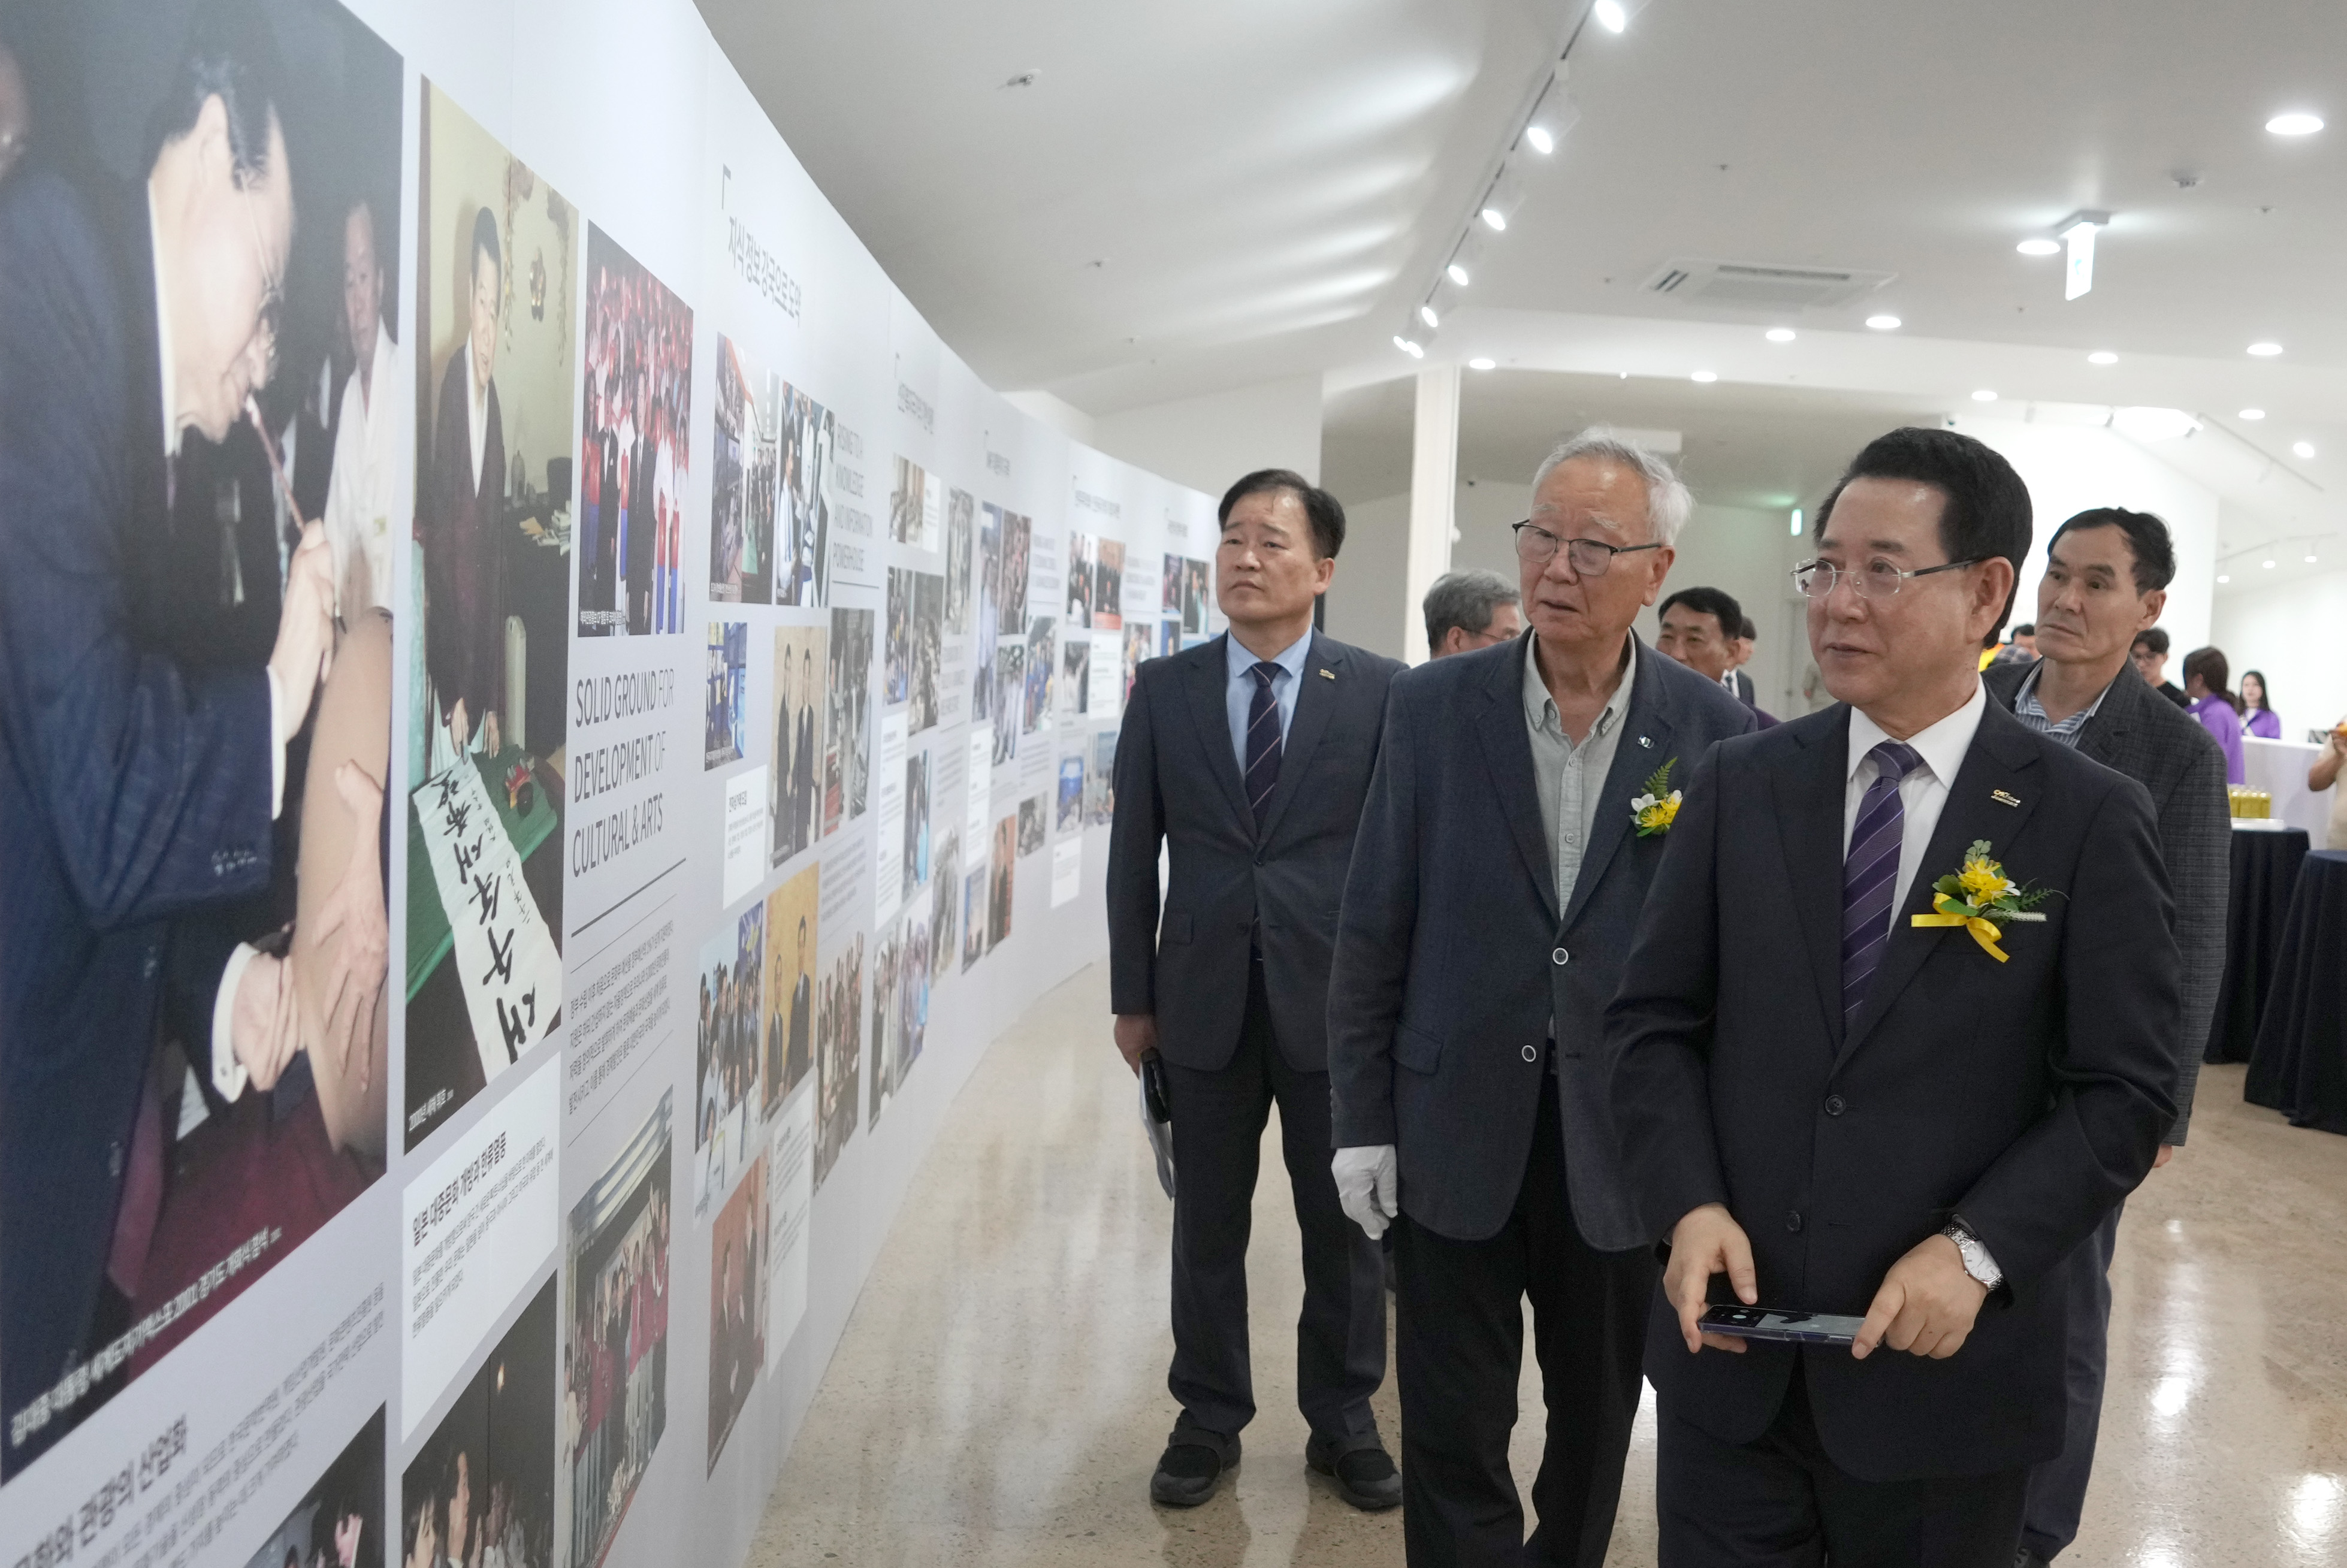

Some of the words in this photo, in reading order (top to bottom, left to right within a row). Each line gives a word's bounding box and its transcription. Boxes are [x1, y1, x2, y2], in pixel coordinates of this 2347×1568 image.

[728, 216, 744, 276] 지식
[745, 232, 760, 286] 정보
[762, 249, 787, 312] 강국으로
[788, 279, 801, 328] 도약
[836, 463, 864, 499] KNOWLEDGE
[844, 506, 872, 537] INFORMATION
[833, 542, 865, 572] POWERHOUSE
[576, 677, 611, 727] SOLID
[615, 670, 656, 718] GROUND
[659, 669, 673, 708] FOR
[575, 735, 653, 803] DEVELOPMENT
[655, 731, 666, 772] OF
[573, 809, 629, 877] CULTURAL
[632, 805, 638, 845] &
[641, 793, 662, 841] ARTS
[570, 998, 579, 1019] 정부
[579, 990, 587, 1008] 수립
[596, 971, 611, 995] 처음으로
[570, 1025, 582, 1047] 지원은
[412, 1209, 428, 1247] 일본
[430, 1179, 459, 1226] 대중문화
[460, 1156, 480, 1196] 개방과
[481, 1131, 506, 1177] 한류열풍
